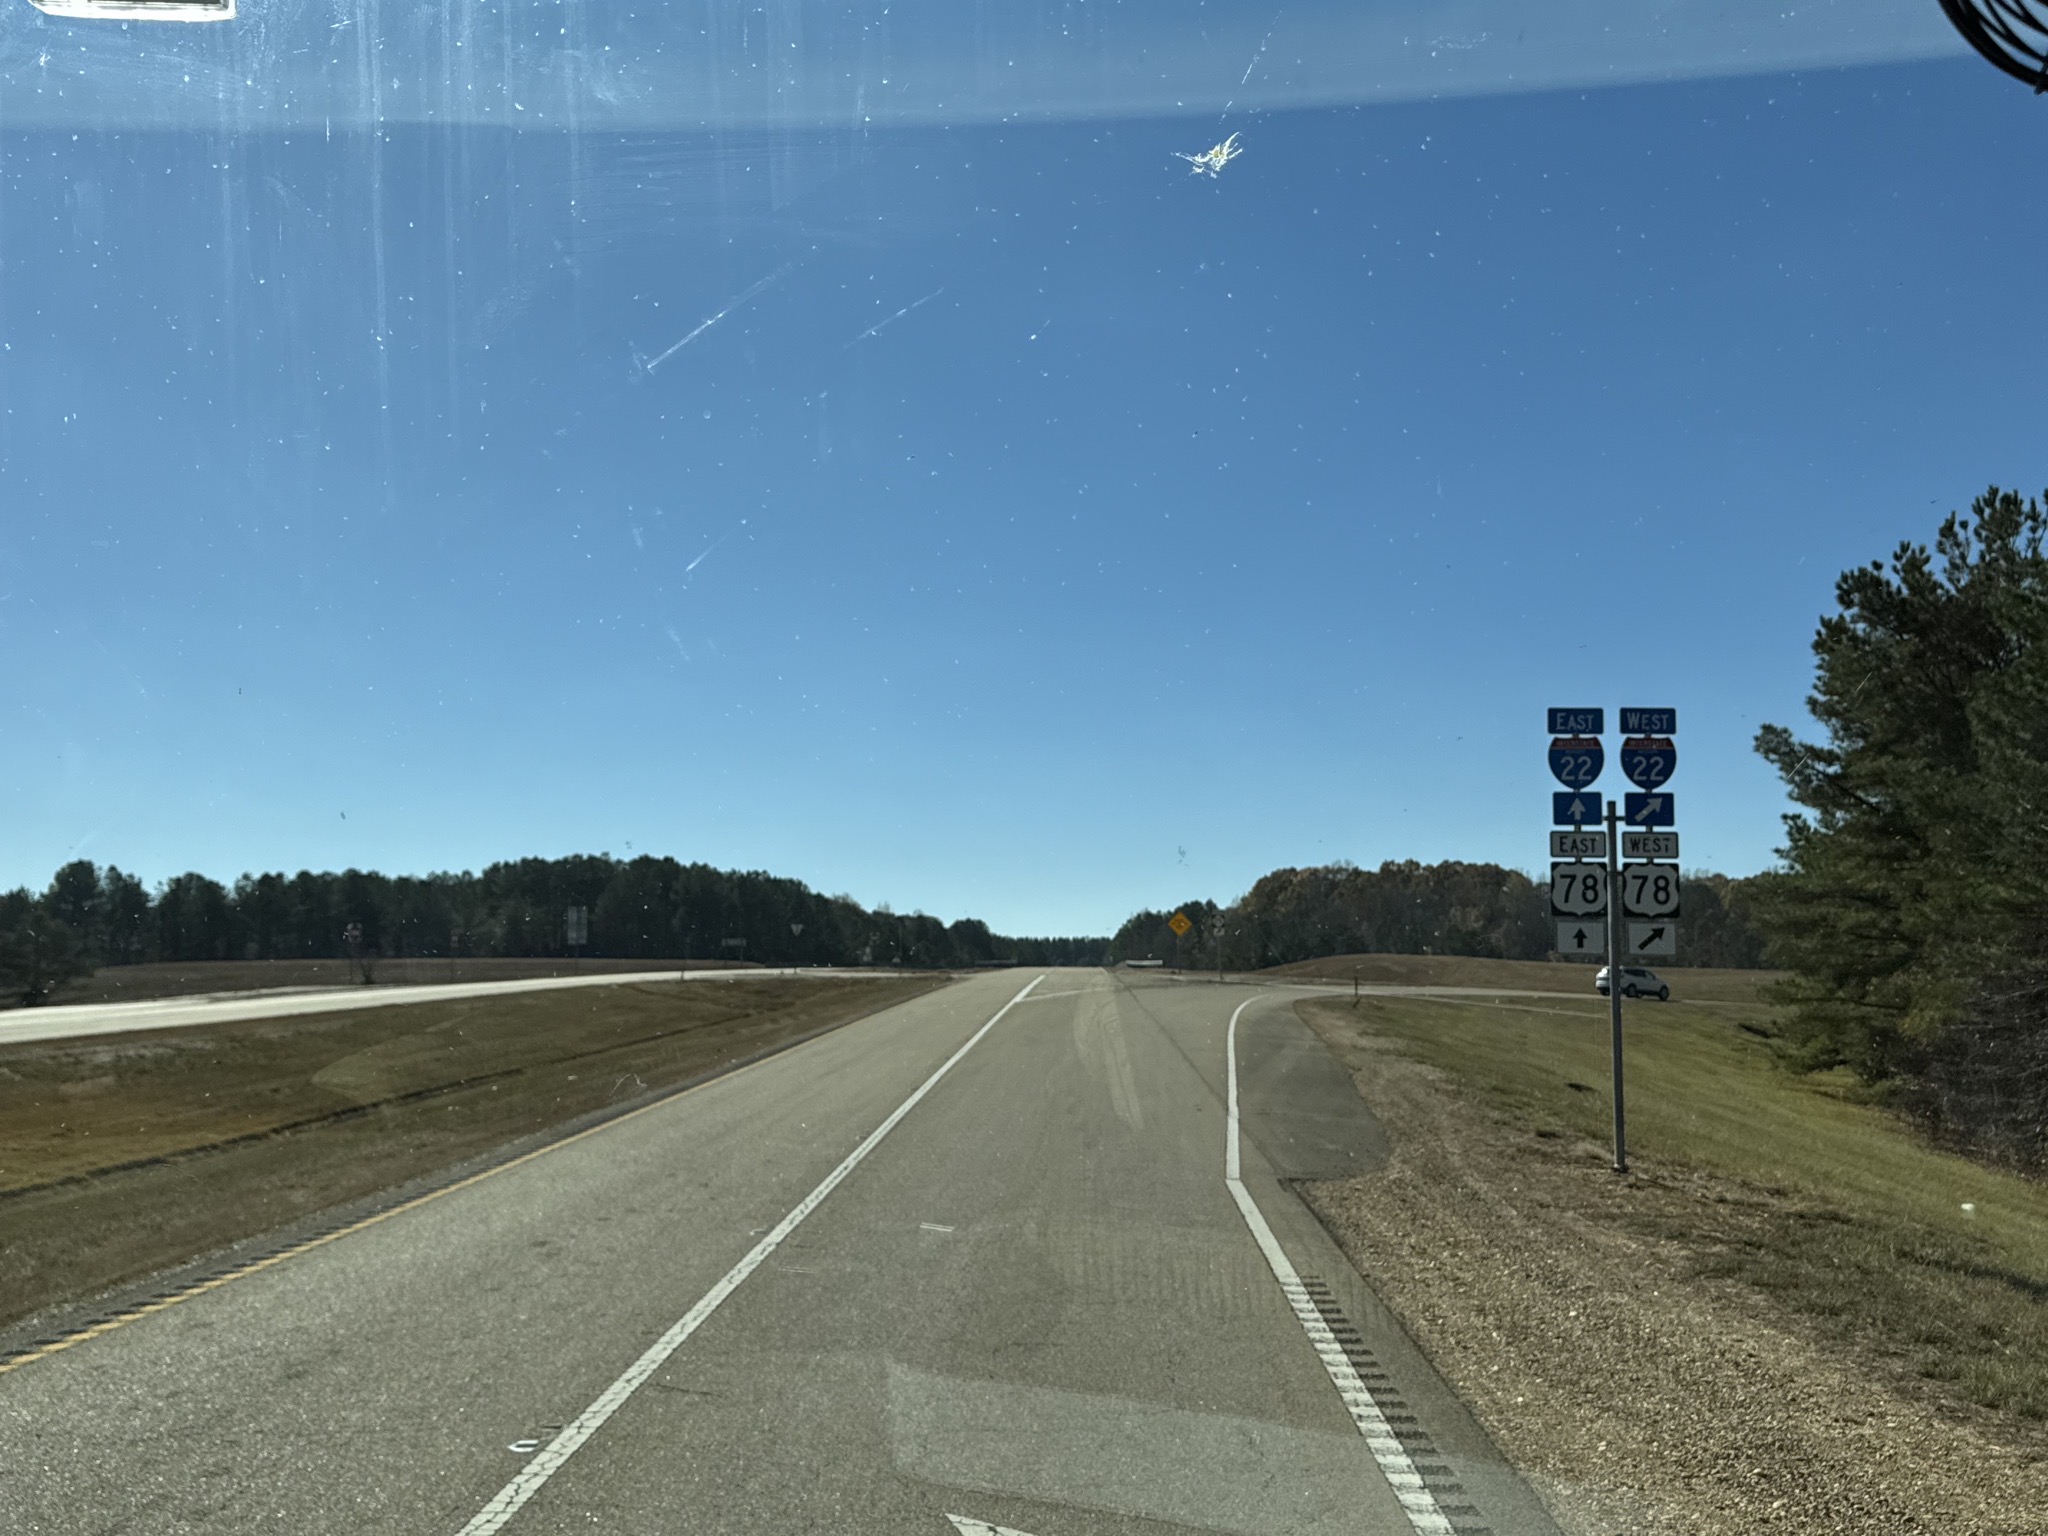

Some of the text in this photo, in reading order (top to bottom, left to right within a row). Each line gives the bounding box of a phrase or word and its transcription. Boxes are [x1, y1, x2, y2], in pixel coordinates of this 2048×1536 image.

[1556, 712, 1595, 730] EAST
[1627, 712, 1669, 730] WEST
[1559, 756, 1592, 781] 22
[1632, 756, 1665, 781] 22
[1558, 836, 1597, 853] EAST
[1629, 837, 1670, 853] WEST
[1559, 874, 1599, 905] 78
[1631, 875, 1670, 905] 78
